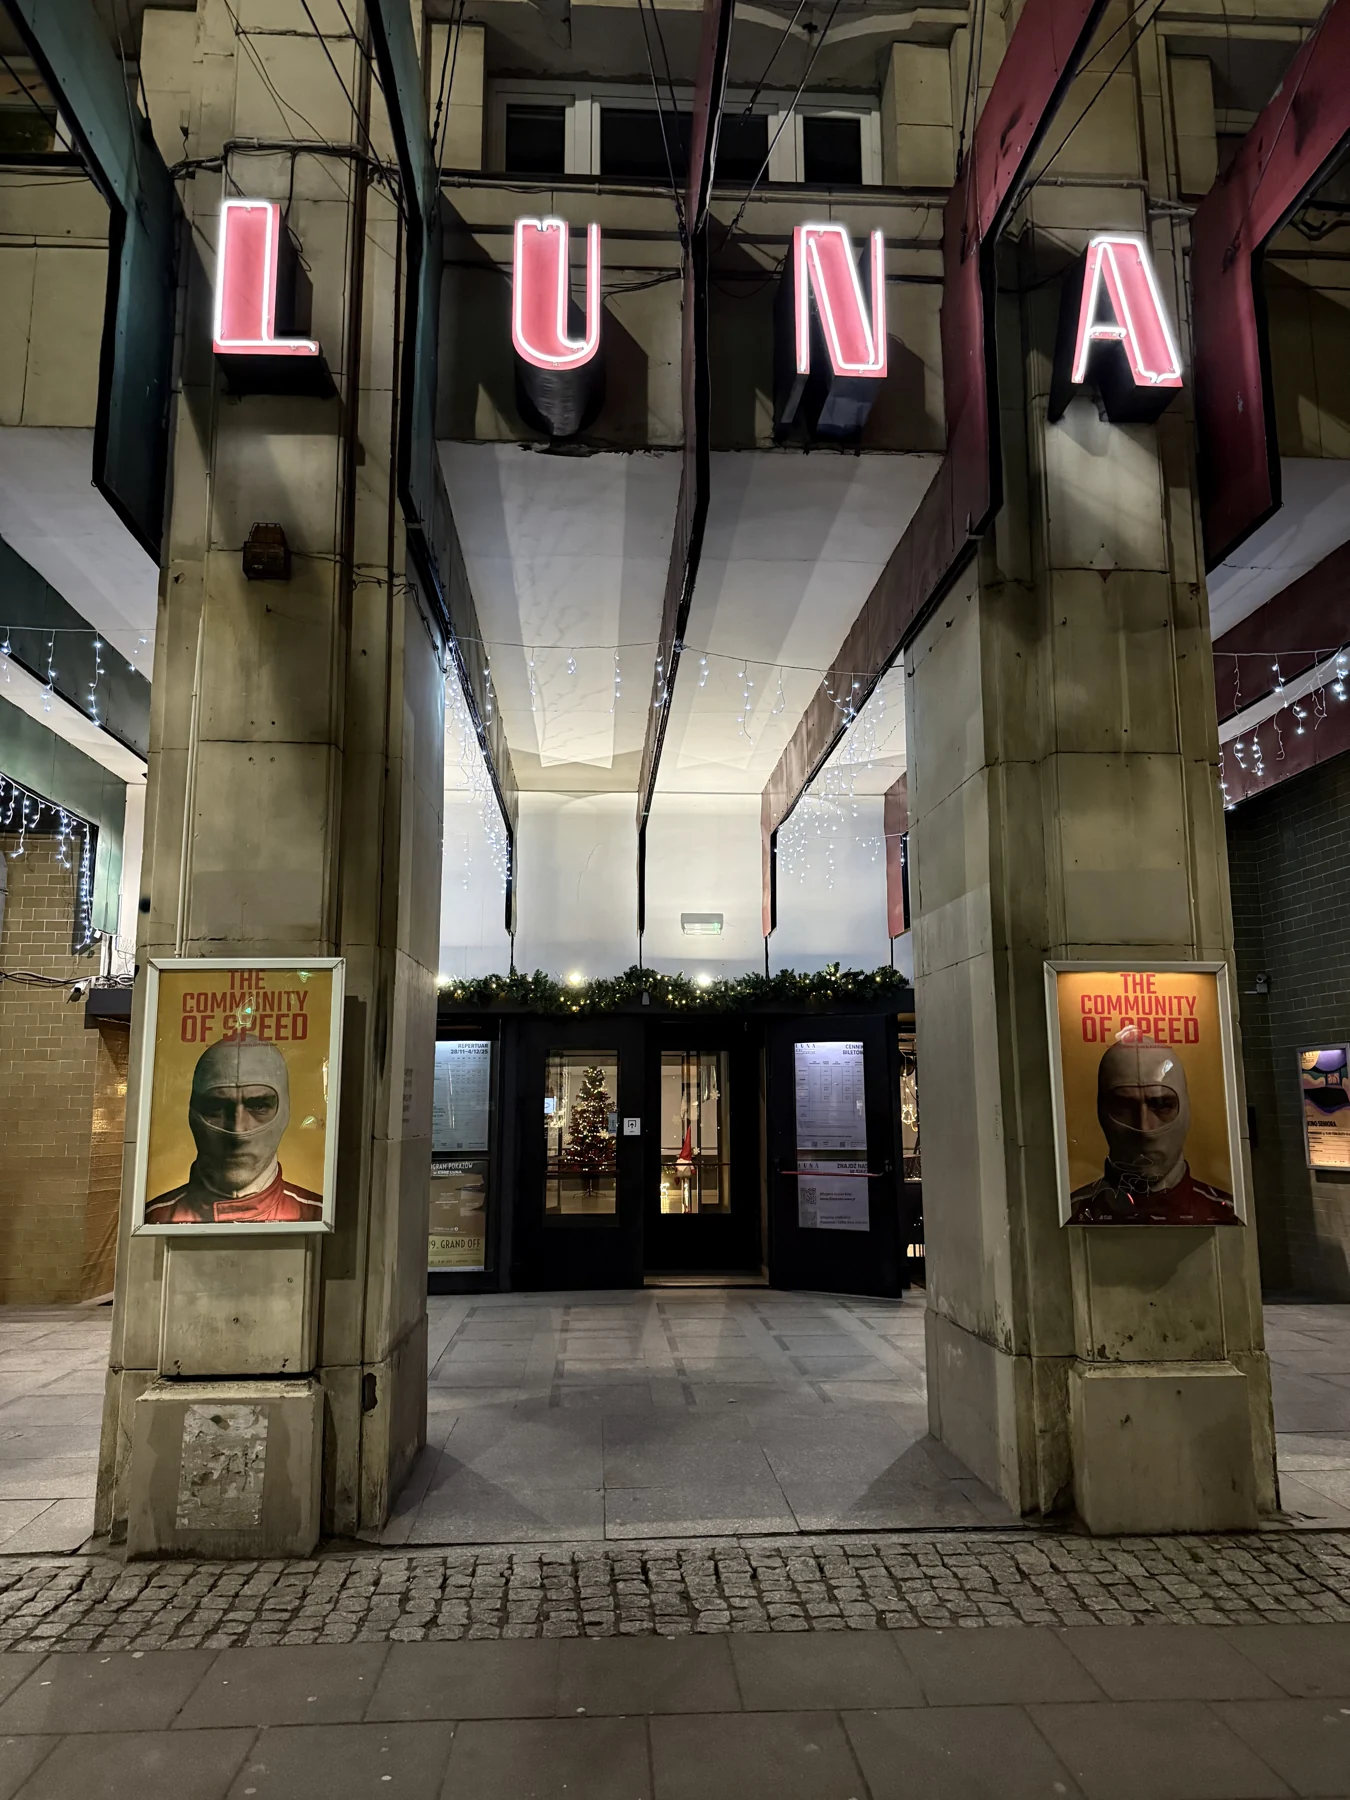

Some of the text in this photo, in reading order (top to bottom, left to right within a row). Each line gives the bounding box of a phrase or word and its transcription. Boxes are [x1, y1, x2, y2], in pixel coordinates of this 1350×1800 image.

[213, 199, 1183, 389] LUNA
[227, 970, 266, 990] THE
[1120, 973, 1156, 994] THE
[183, 990, 309, 1013] COMMUNITY
[1080, 995, 1196, 1016] COMMUNITY
[181, 1012, 308, 1043] OF SPEED
[1082, 1017, 1200, 1044] OF SPEED
[440, 1239, 465, 1249] GRAND
[467, 1238, 481, 1248] OFF
